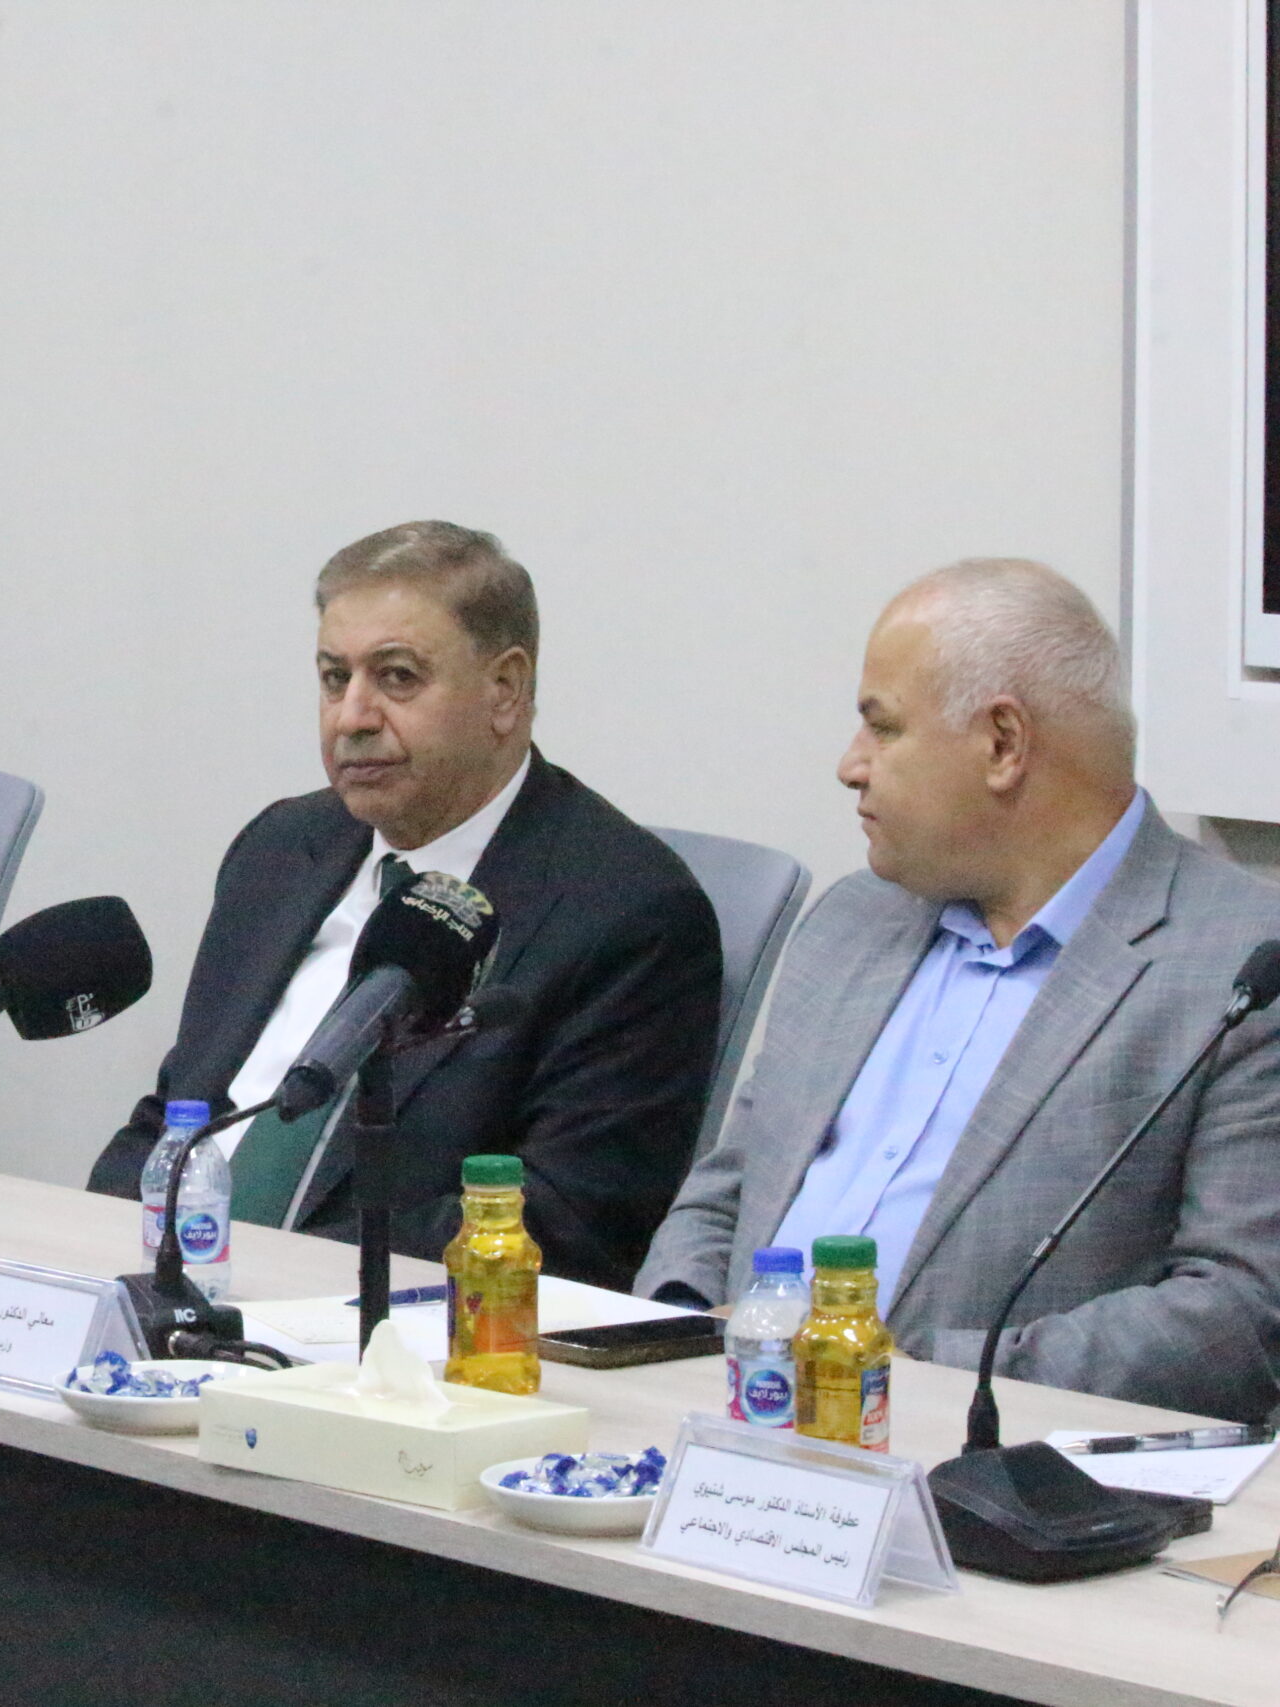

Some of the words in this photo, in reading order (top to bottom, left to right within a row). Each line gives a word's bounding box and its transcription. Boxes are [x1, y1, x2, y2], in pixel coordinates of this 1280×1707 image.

[27, 1311, 54, 1330] معالي
[758, 1497, 792, 1512] الدكتور
[829, 1505, 860, 1528] عطوفة
[784, 1537, 823, 1557] المجلس
[824, 1550, 851, 1568] رئيس
